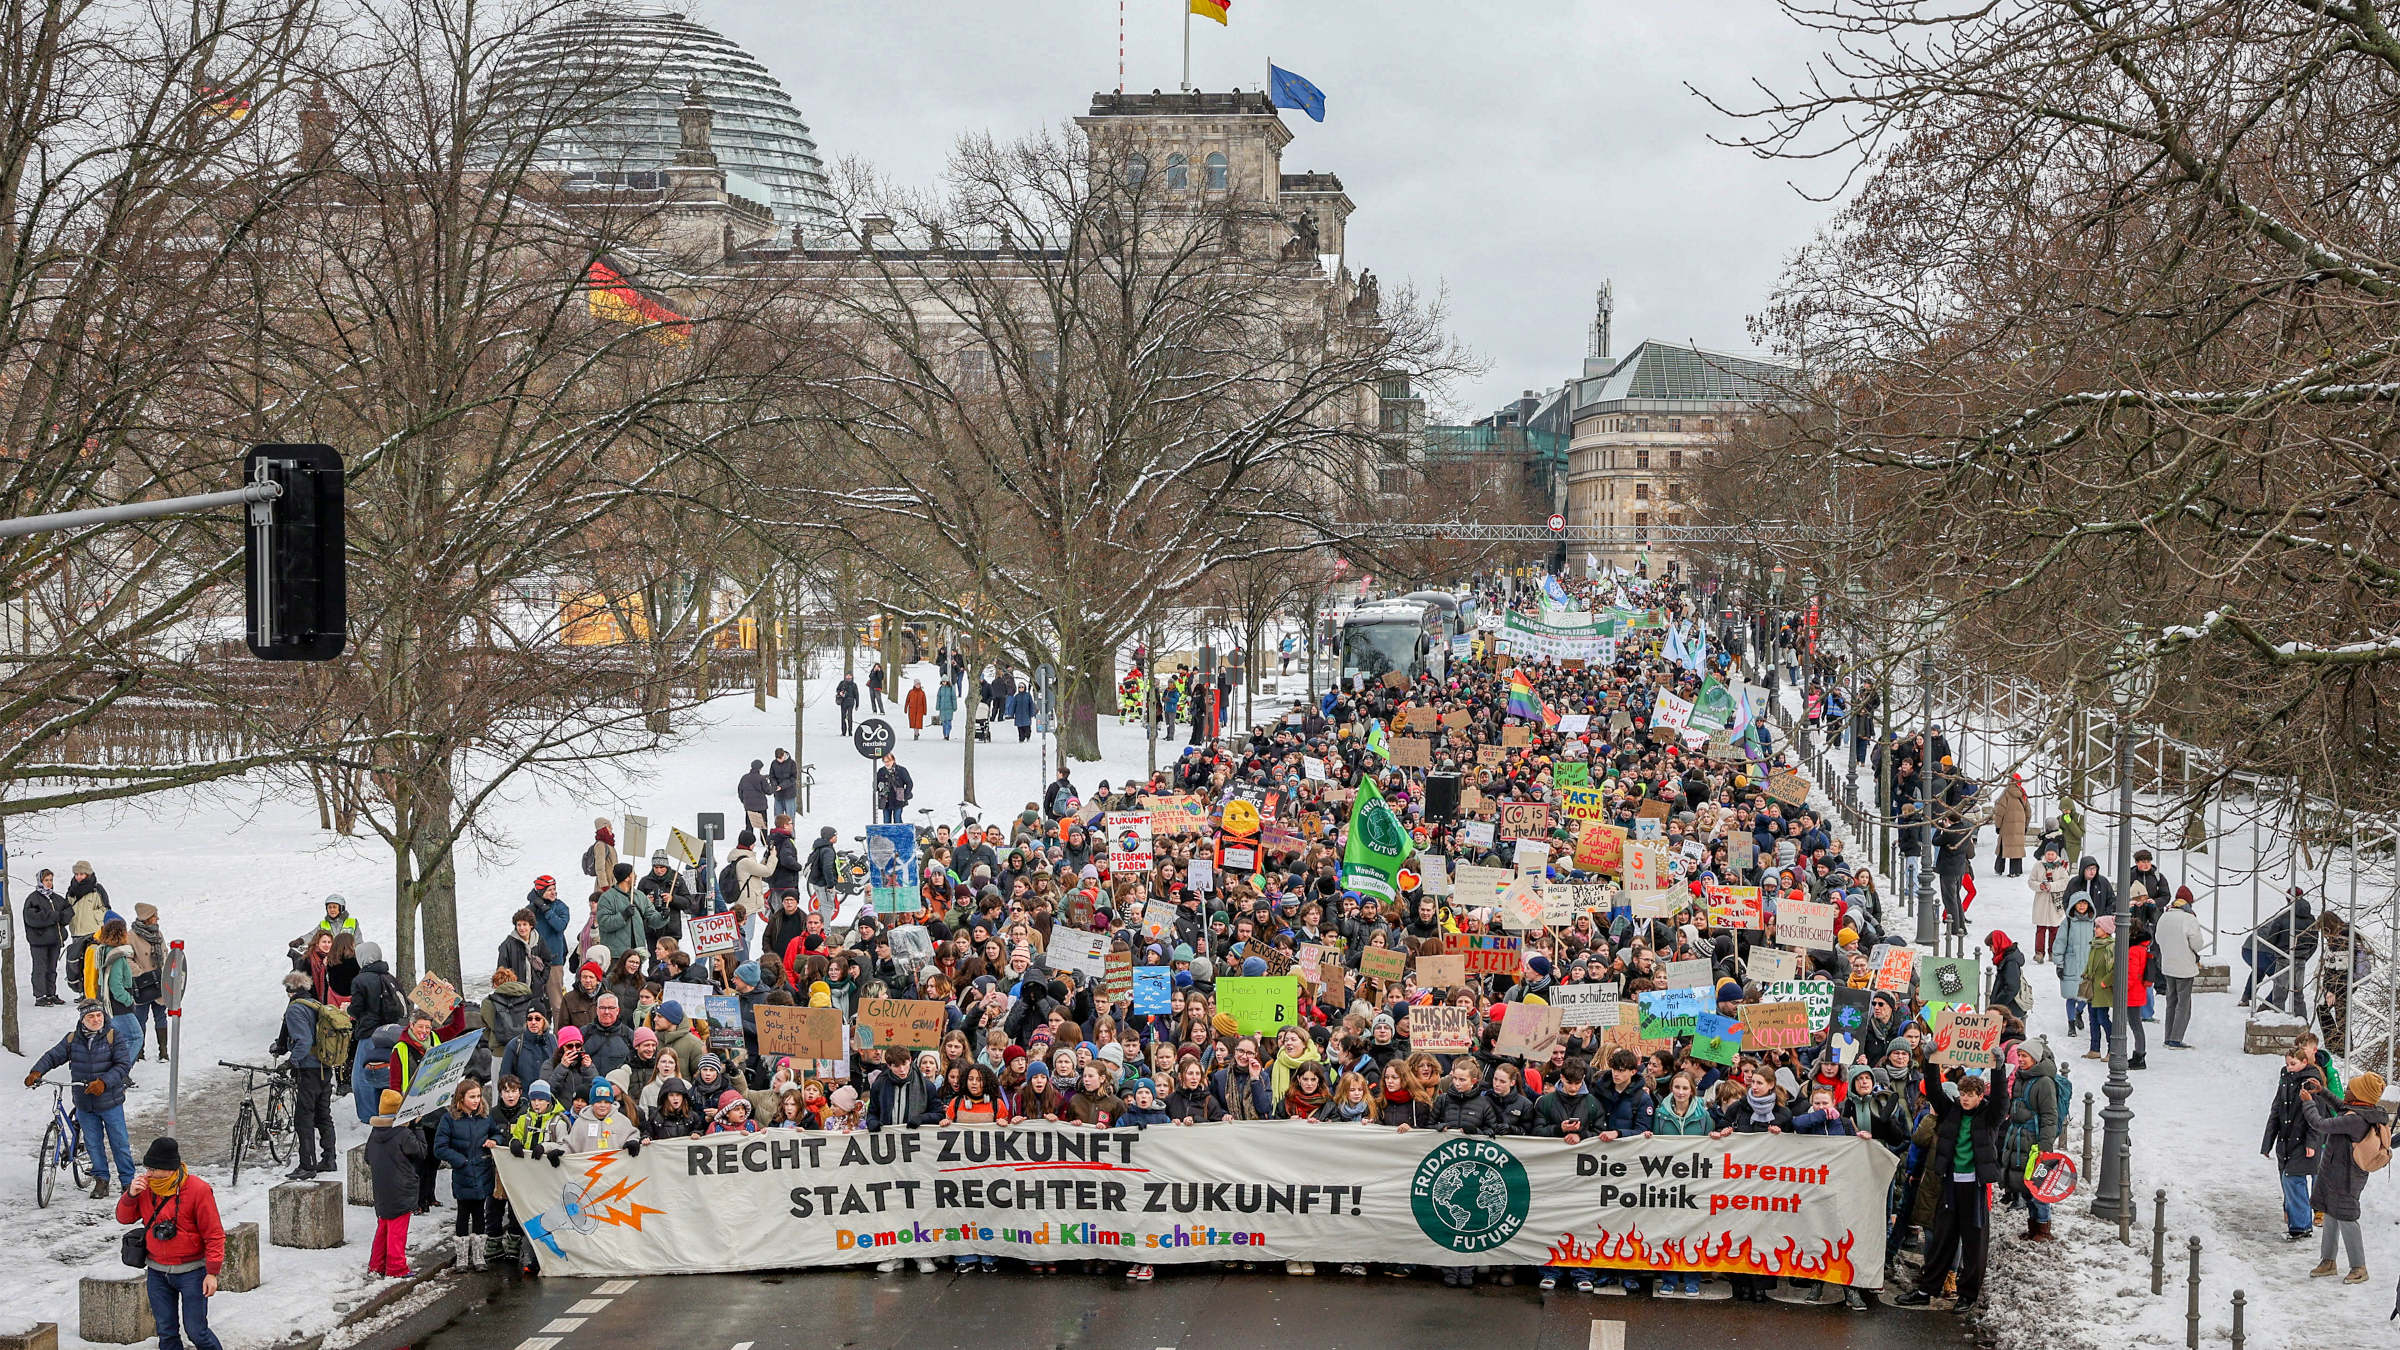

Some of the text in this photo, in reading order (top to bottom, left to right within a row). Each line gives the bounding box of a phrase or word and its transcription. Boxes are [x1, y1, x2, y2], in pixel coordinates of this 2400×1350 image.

[1669, 699, 1688, 715] Wir
[1662, 713, 1677, 725] die
[1569, 790, 1599, 806] ACT
[1532, 807, 1543, 819] is
[1568, 805, 1601, 819] NOW
[1108, 816, 1152, 825] ZUKUNFT
[1502, 826, 1511, 837] in
[1513, 825, 1529, 837] the
[1529, 823, 1547, 837] Air
[1589, 826, 1612, 838] eine
[1582, 833, 1620, 854] Zukunft
[1110, 852, 1153, 862] SEIDENEN
[1590, 847, 1608, 856] war
[1117, 861, 1147, 871] FADEN
[1631, 851, 1644, 871] 5
[1572, 885, 1589, 896] DAS
[1778, 902, 1829, 918] KLIMASCHUTZ
[696, 919, 724, 934] STOP
[1798, 916, 1807, 925] IST
[699, 932, 736, 946] PLASTIK
[1776, 924, 1833, 943] MENSCHENSCHUTZ
[1318, 950, 1339, 965] ACT
[1360, 967, 1400, 980] KLIMASCHUTZ
[1266, 984, 1281, 995] no
[1550, 984, 1618, 1006] Klima schützen
[1798, 981, 1835, 996] BOCK
[867, 999, 916, 1018] GRÜN
[1666, 1001, 1680, 1010] mit
[764, 1008, 782, 1018] ohne
[1411, 1007, 1440, 1026] THIS
[1660, 1011, 1697, 1028] Klima
[1955, 1016, 1989, 1027] DON'T
[777, 1030, 797, 1043] dich
[1958, 1029, 1985, 1039] BURN
[769, 1038, 802, 1054] NICHT
[1957, 1040, 1981, 1051] OUR
[1949, 1051, 1990, 1064] FUTURE
[688, 1130, 1140, 1176] RECHT AUF ZUKUNFT
[1413, 1142, 1511, 1198] FRIDAYS FOR
[1576, 1152, 1830, 1186] Die Welt brennt
[790, 1179, 1362, 1218] STATT RECHTER ZUKUNFT!
[1599, 1184, 1802, 1216] Politik pennt
[836, 1220, 1266, 1251] Demokratie und Klima schützen
[1452, 1213, 1522, 1251] FUTURE
